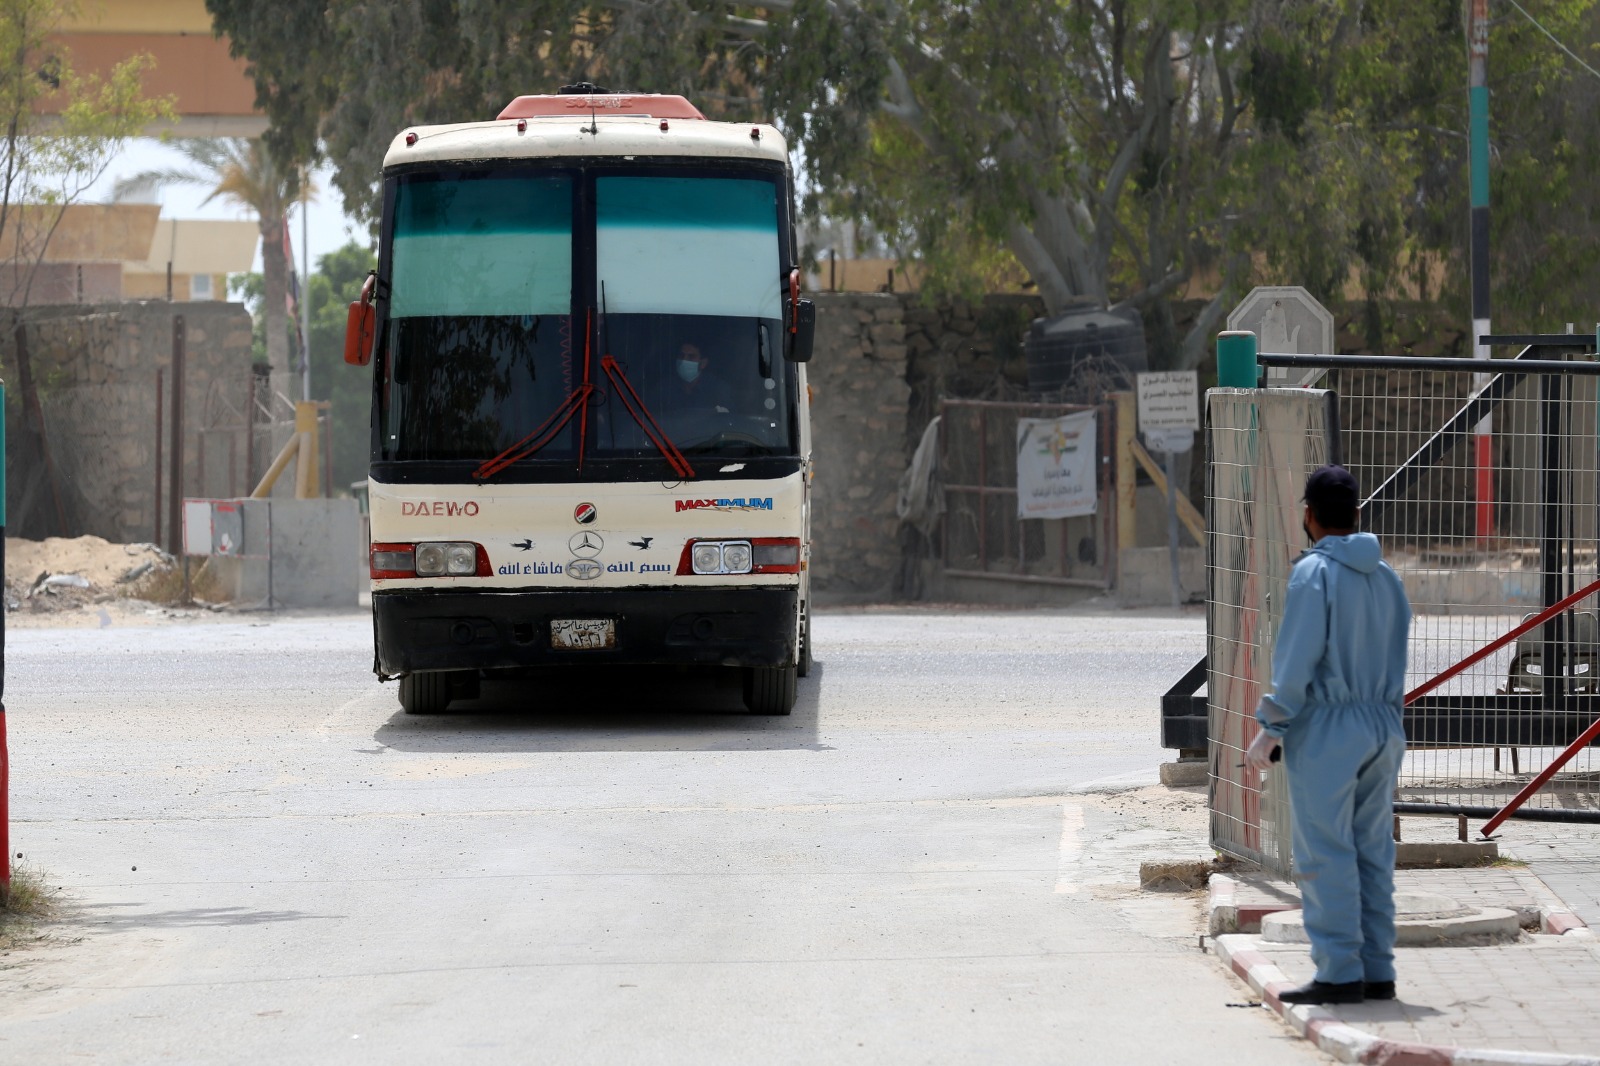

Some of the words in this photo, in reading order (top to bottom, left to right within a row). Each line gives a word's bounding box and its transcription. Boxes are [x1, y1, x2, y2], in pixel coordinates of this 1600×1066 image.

[402, 501, 479, 516] DAEWO
[675, 498, 773, 512] MAXIMUM
[498, 561, 521, 575] الله
[606, 561, 635, 573] الله
[638, 563, 671, 574] بسم
